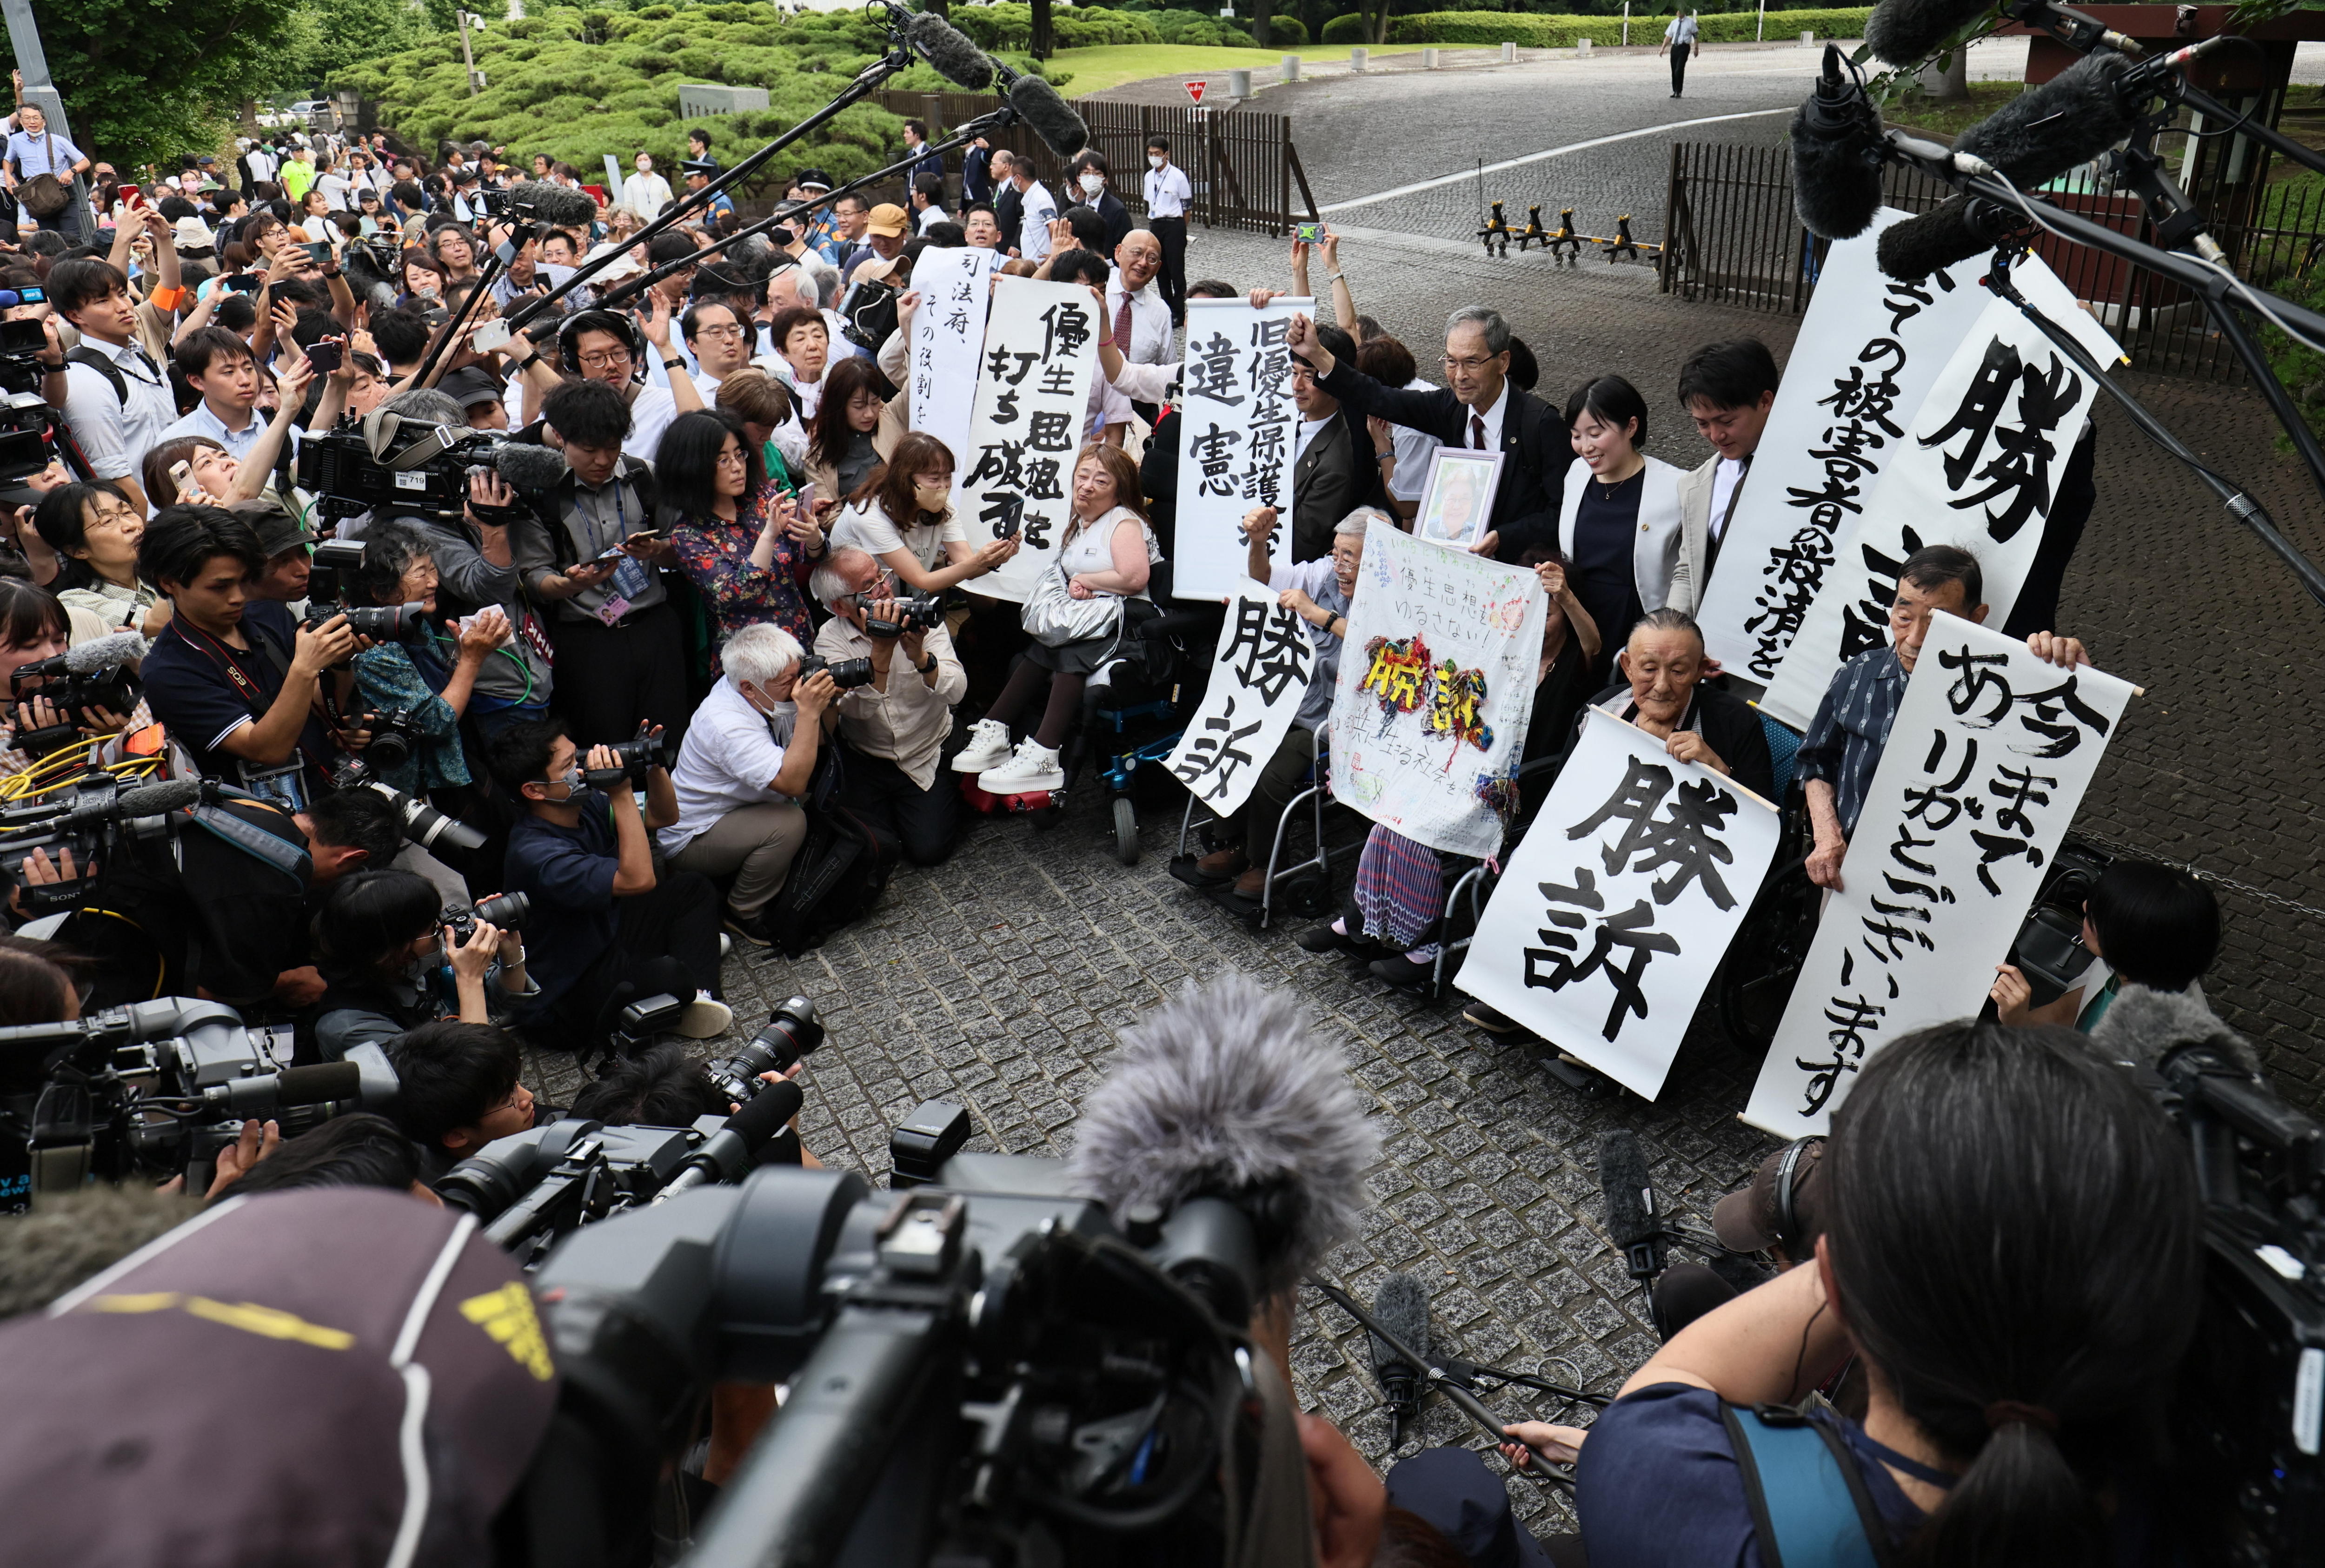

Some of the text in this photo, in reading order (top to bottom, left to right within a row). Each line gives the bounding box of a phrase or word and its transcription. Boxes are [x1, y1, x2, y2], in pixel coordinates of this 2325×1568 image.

[917, 295, 937, 424] その役割を
[944, 253, 980, 344] 司法府、
[1023, 302, 1090, 550] 優生思想を
[1187, 331, 1245, 498] 違憲
[528, 622, 553, 659] NHK
[1400, 566, 1487, 626] 優生思想を
[227, 666, 246, 686] EOS
[1172, 595, 1310, 801] 勝訴
[1970, 674, 2110, 897] 今まで
[1523, 754, 1739, 1043] 勝訴
